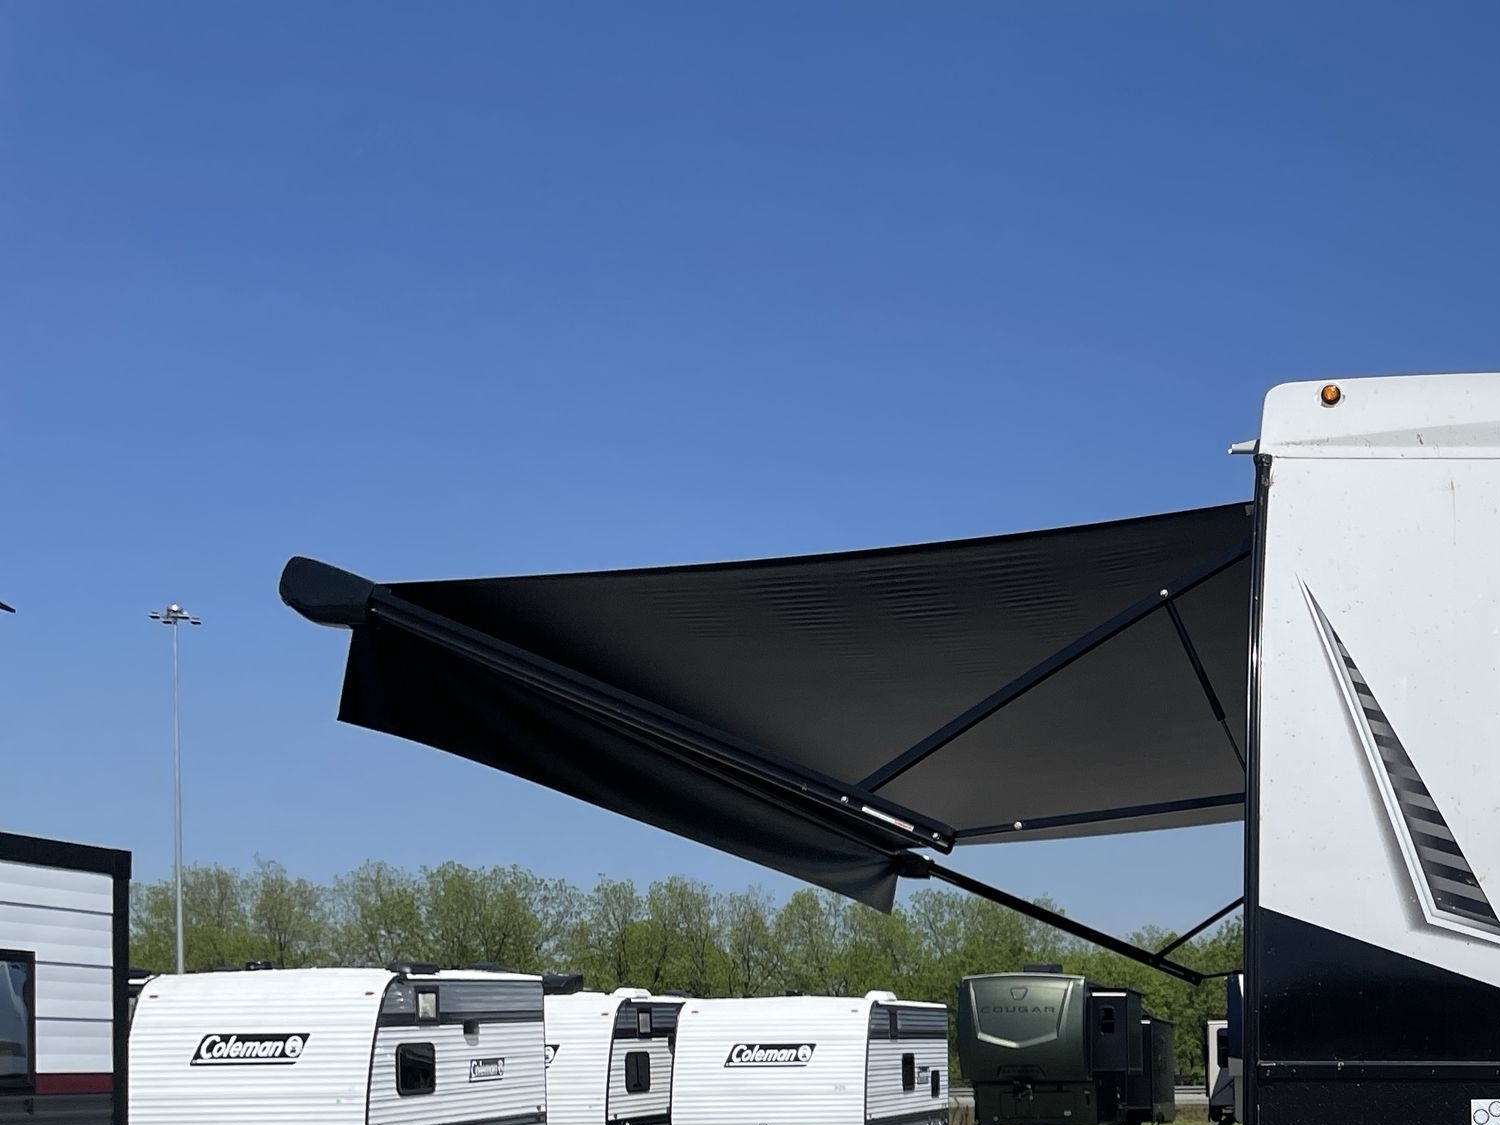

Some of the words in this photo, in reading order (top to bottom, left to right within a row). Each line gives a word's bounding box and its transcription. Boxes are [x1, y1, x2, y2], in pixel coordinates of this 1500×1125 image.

[981, 1006, 1055, 1014] COUGAR
[200, 1035, 284, 1059] Coleman
[731, 1044, 797, 1063] Coleman
